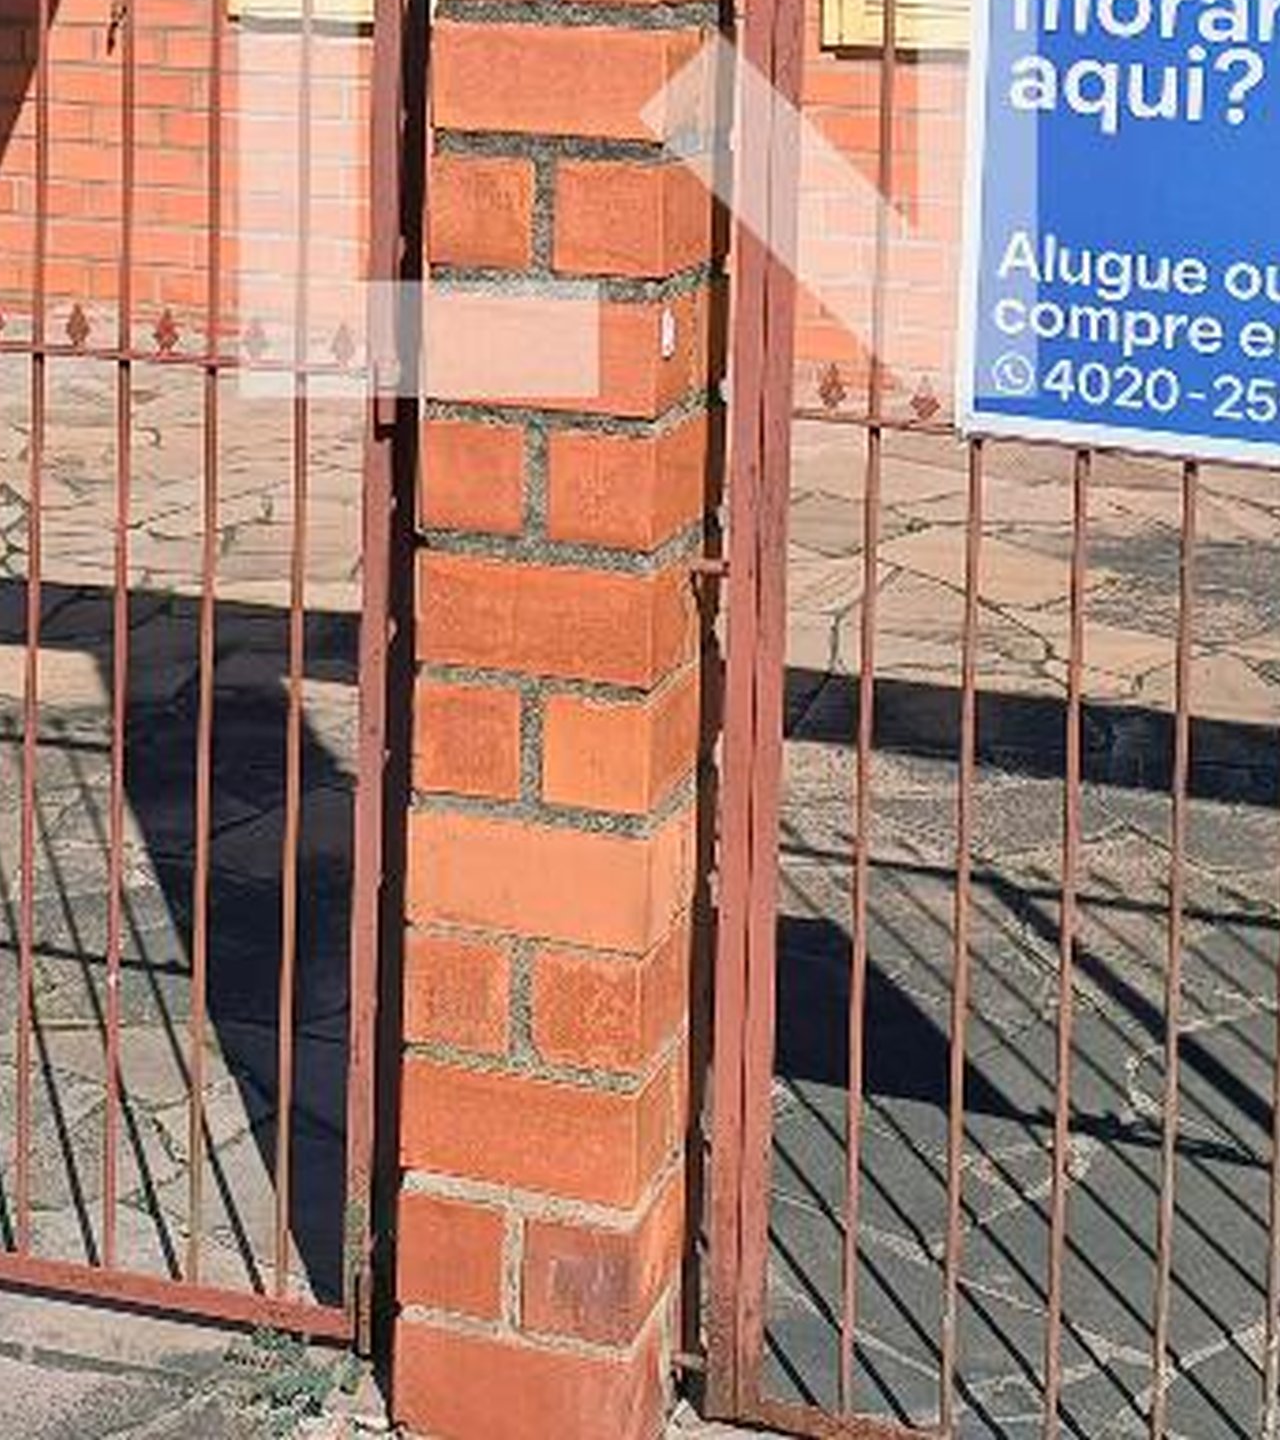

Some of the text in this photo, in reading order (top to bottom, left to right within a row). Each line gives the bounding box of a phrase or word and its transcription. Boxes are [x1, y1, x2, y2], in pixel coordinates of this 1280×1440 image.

[1008, 48, 1266, 133] aqui?
[997, 233, 1210, 302] Alugue
[993, 299, 1221, 356] compre
